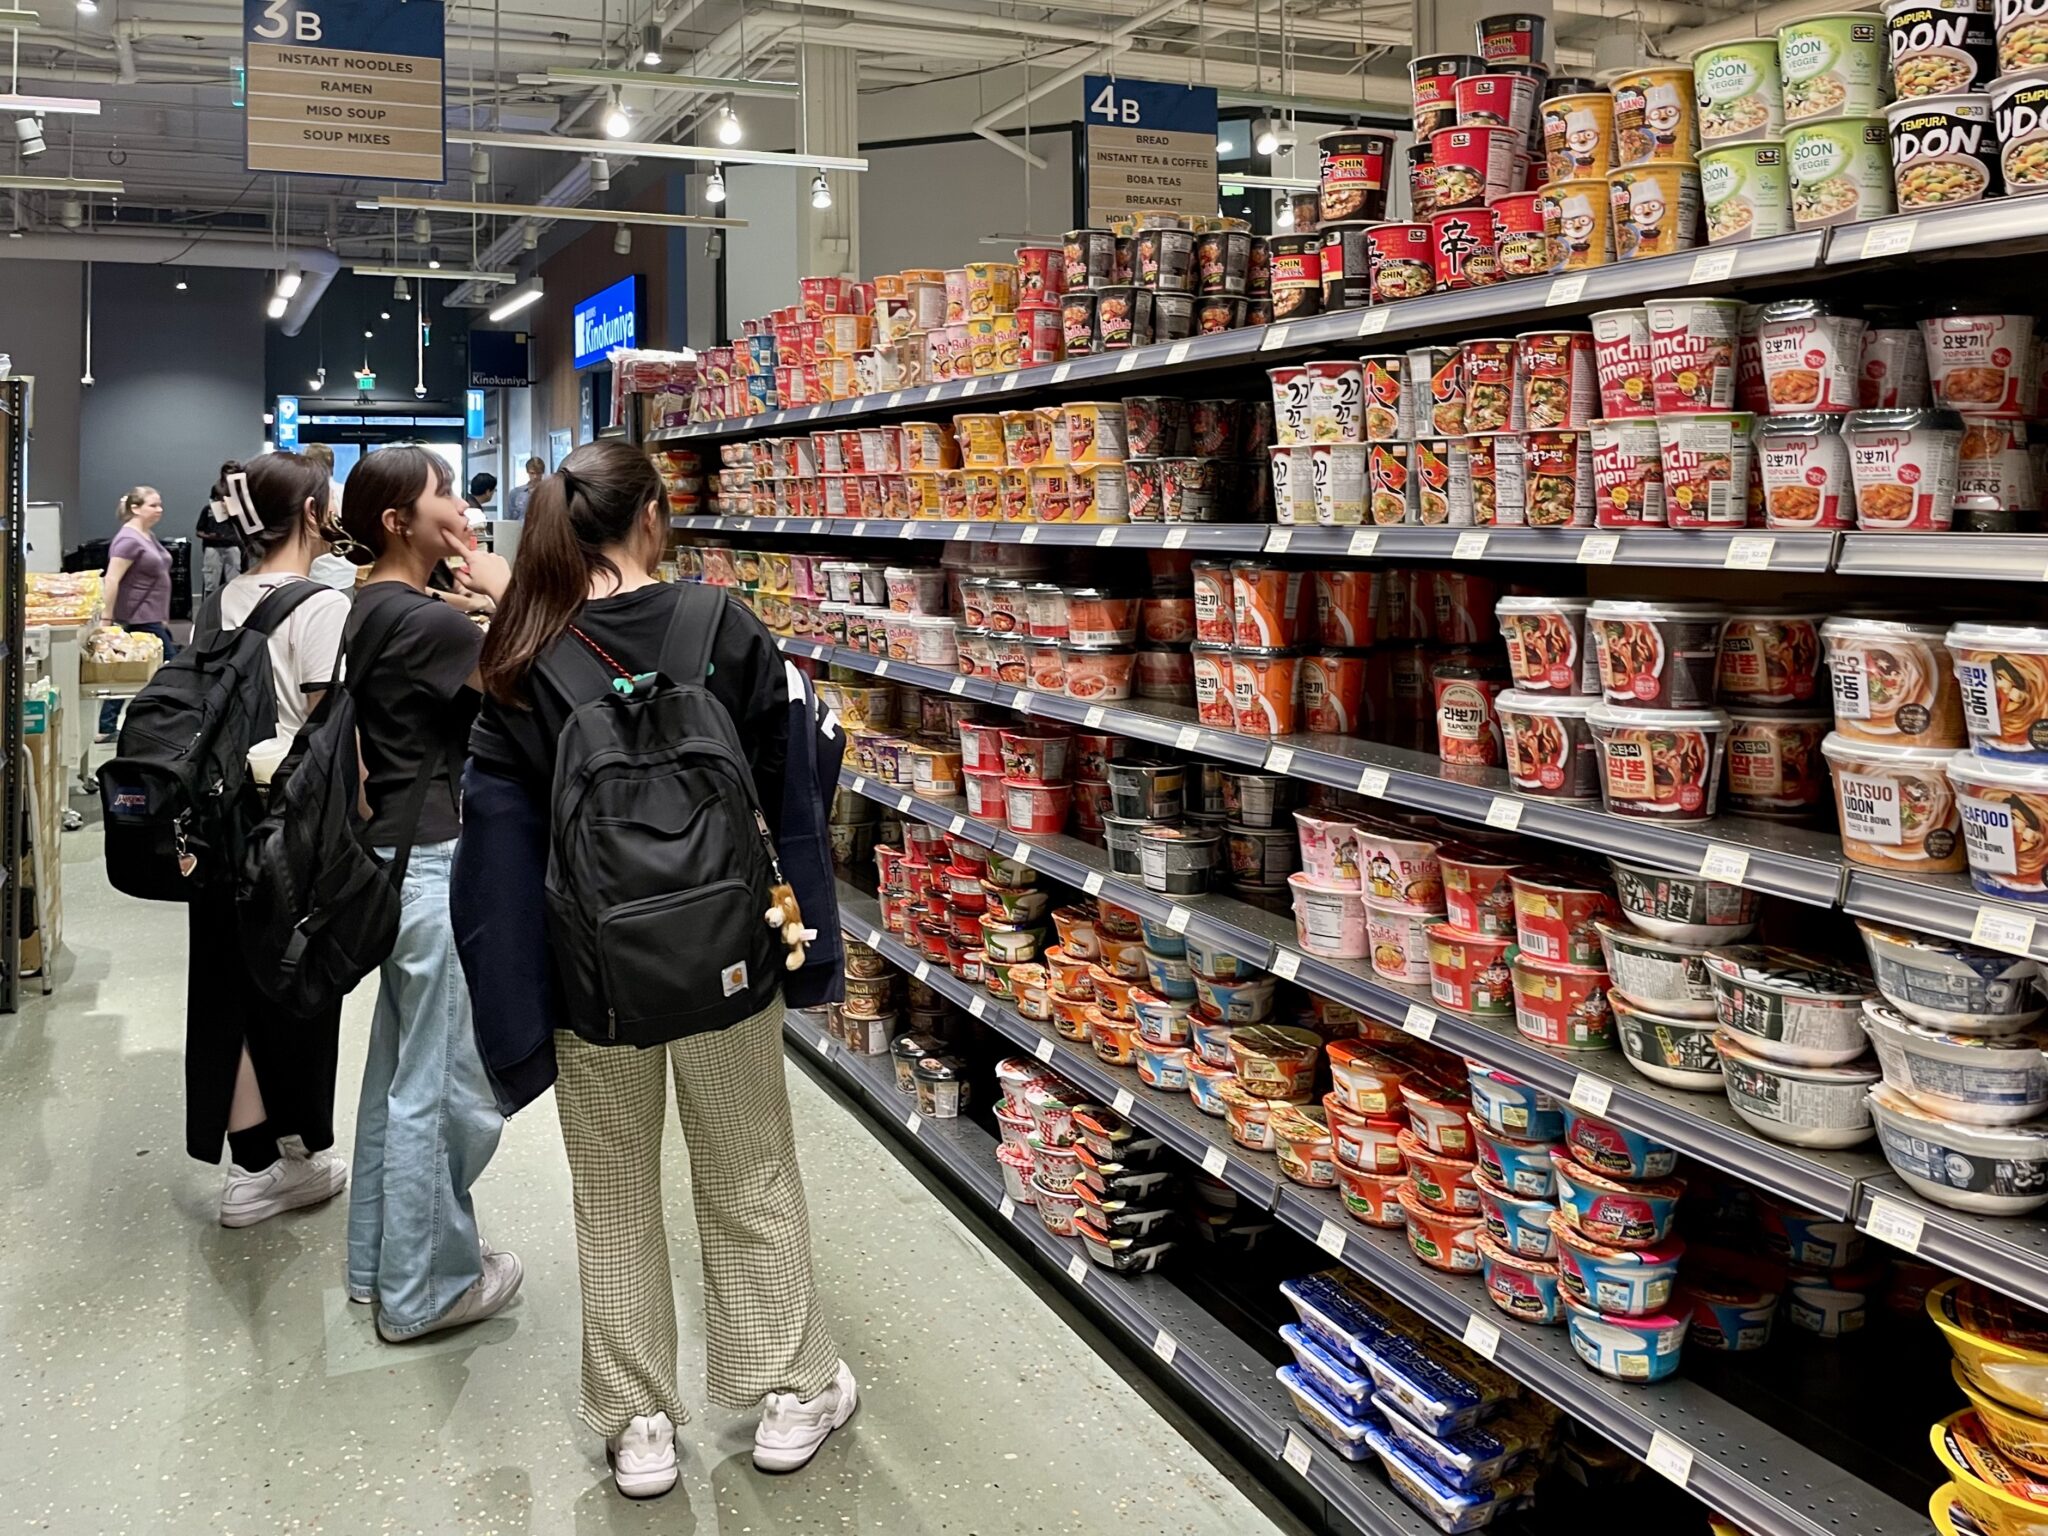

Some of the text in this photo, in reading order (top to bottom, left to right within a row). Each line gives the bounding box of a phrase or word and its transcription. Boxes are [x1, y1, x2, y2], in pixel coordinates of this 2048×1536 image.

[253, 0, 322, 41] 3B
[1893, 10, 1932, 28] TEMPURA
[1489, 37, 1512, 45] SHIN
[1891, 16, 1968, 59] DON
[1785, 41, 1821, 59] SOON
[278, 53, 413, 73] INSTANT NOODLES
[1788, 56, 1818, 69] VEGGIE
[1707, 63, 1747, 81] SOON
[321, 81, 372, 94] RAMEN
[1711, 78, 1744, 90] VEGGIE
[1091, 85, 1140, 124] 4B
[306, 105, 386, 120] MISO SOUP
[1901, 116, 1947, 132] TEMPURA
[303, 130, 390, 145] SOUP MIXES
[1136, 135, 1169, 145] BREAD
[1794, 143, 1833, 160] SOON
[1097, 152, 1208, 168] INSTANT TEA & COFFEE
[1338, 159, 1363, 168] SHIN
[1798, 159, 1830, 170] VEGGIE
[1127, 174, 1181, 186] BOBA TEAS
[1126, 195, 1182, 206] BREAKFAST
[1441, 219, 1478, 274] 辛
[1504, 245, 1527, 255] SHIN
[1381, 270, 1403, 279] SHIN
[585, 305, 635, 354] Kinokuniya
[1765, 337, 1797, 354] 요뽀끼
[1943, 335, 1983, 349] 요뽀끼
[472, 375, 527, 386] Kinokuniya
[1766, 454, 1798, 467] 요뽀끼
[1856, 450, 1889, 464] 요뽀끼
[1833, 674, 1859, 701] 우동
[1446, 700, 1478, 708] ORIGINAL
[1444, 707, 1482, 722] 라뽀끼
[1447, 723, 1477, 731] RAPOKKI
[1608, 757, 1646, 782] 짬뽕
[1843, 779, 1893, 802] KATSUO
[1844, 795, 1874, 815] UDON
[1846, 812, 1891, 827] NOODLE BOWL
[1984, 842, 2005, 855] BOWL
[1671, 884, 1693, 919] 特盛
[2005, 930, 2026, 943] $3.49
